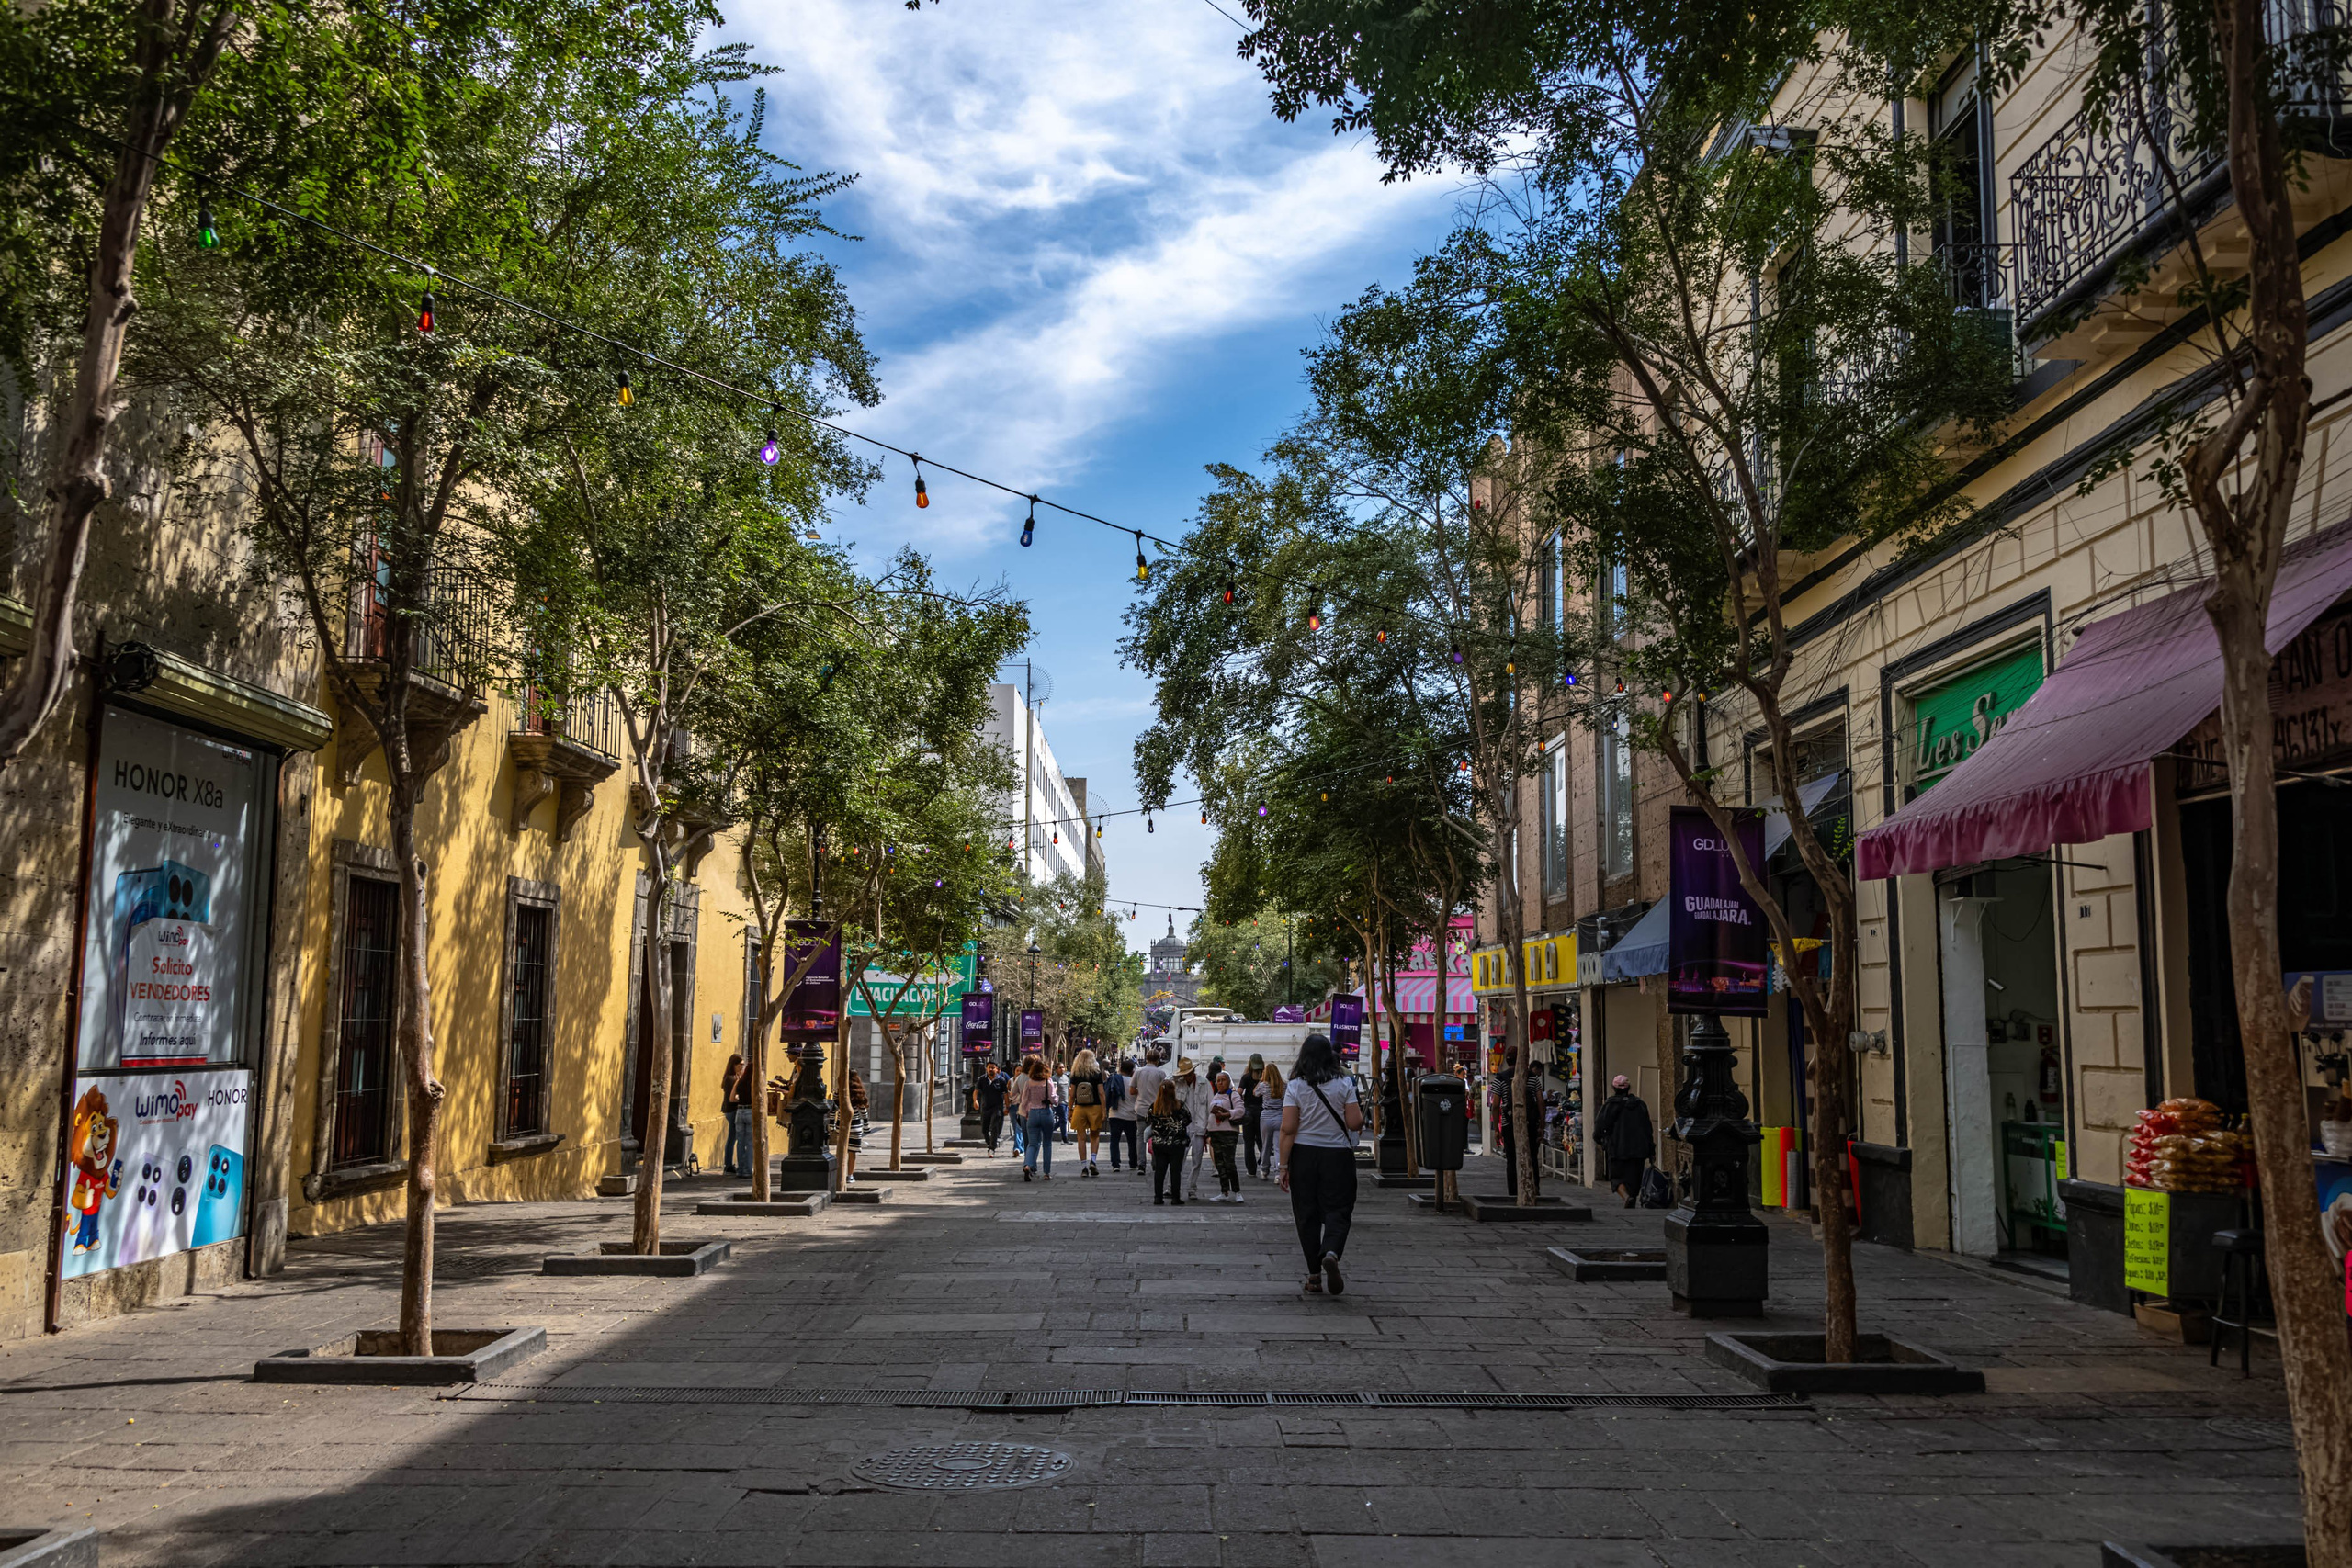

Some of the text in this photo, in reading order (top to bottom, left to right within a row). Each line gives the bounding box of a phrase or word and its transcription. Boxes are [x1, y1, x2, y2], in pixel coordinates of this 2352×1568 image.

[1917, 716, 1962, 772] Les
[114, 759, 224, 809] HONOR X8a
[123, 812, 156, 829] Elegante
[157, 822, 164, 832] y
[1685, 896, 1739, 912] GUADALAJARA
[152, 956, 193, 976] Solicito
[130, 982, 210, 1002] VENDEDORES
[140, 1032, 197, 1048] Informes aquí
[208, 1089, 247, 1106] HONOR
